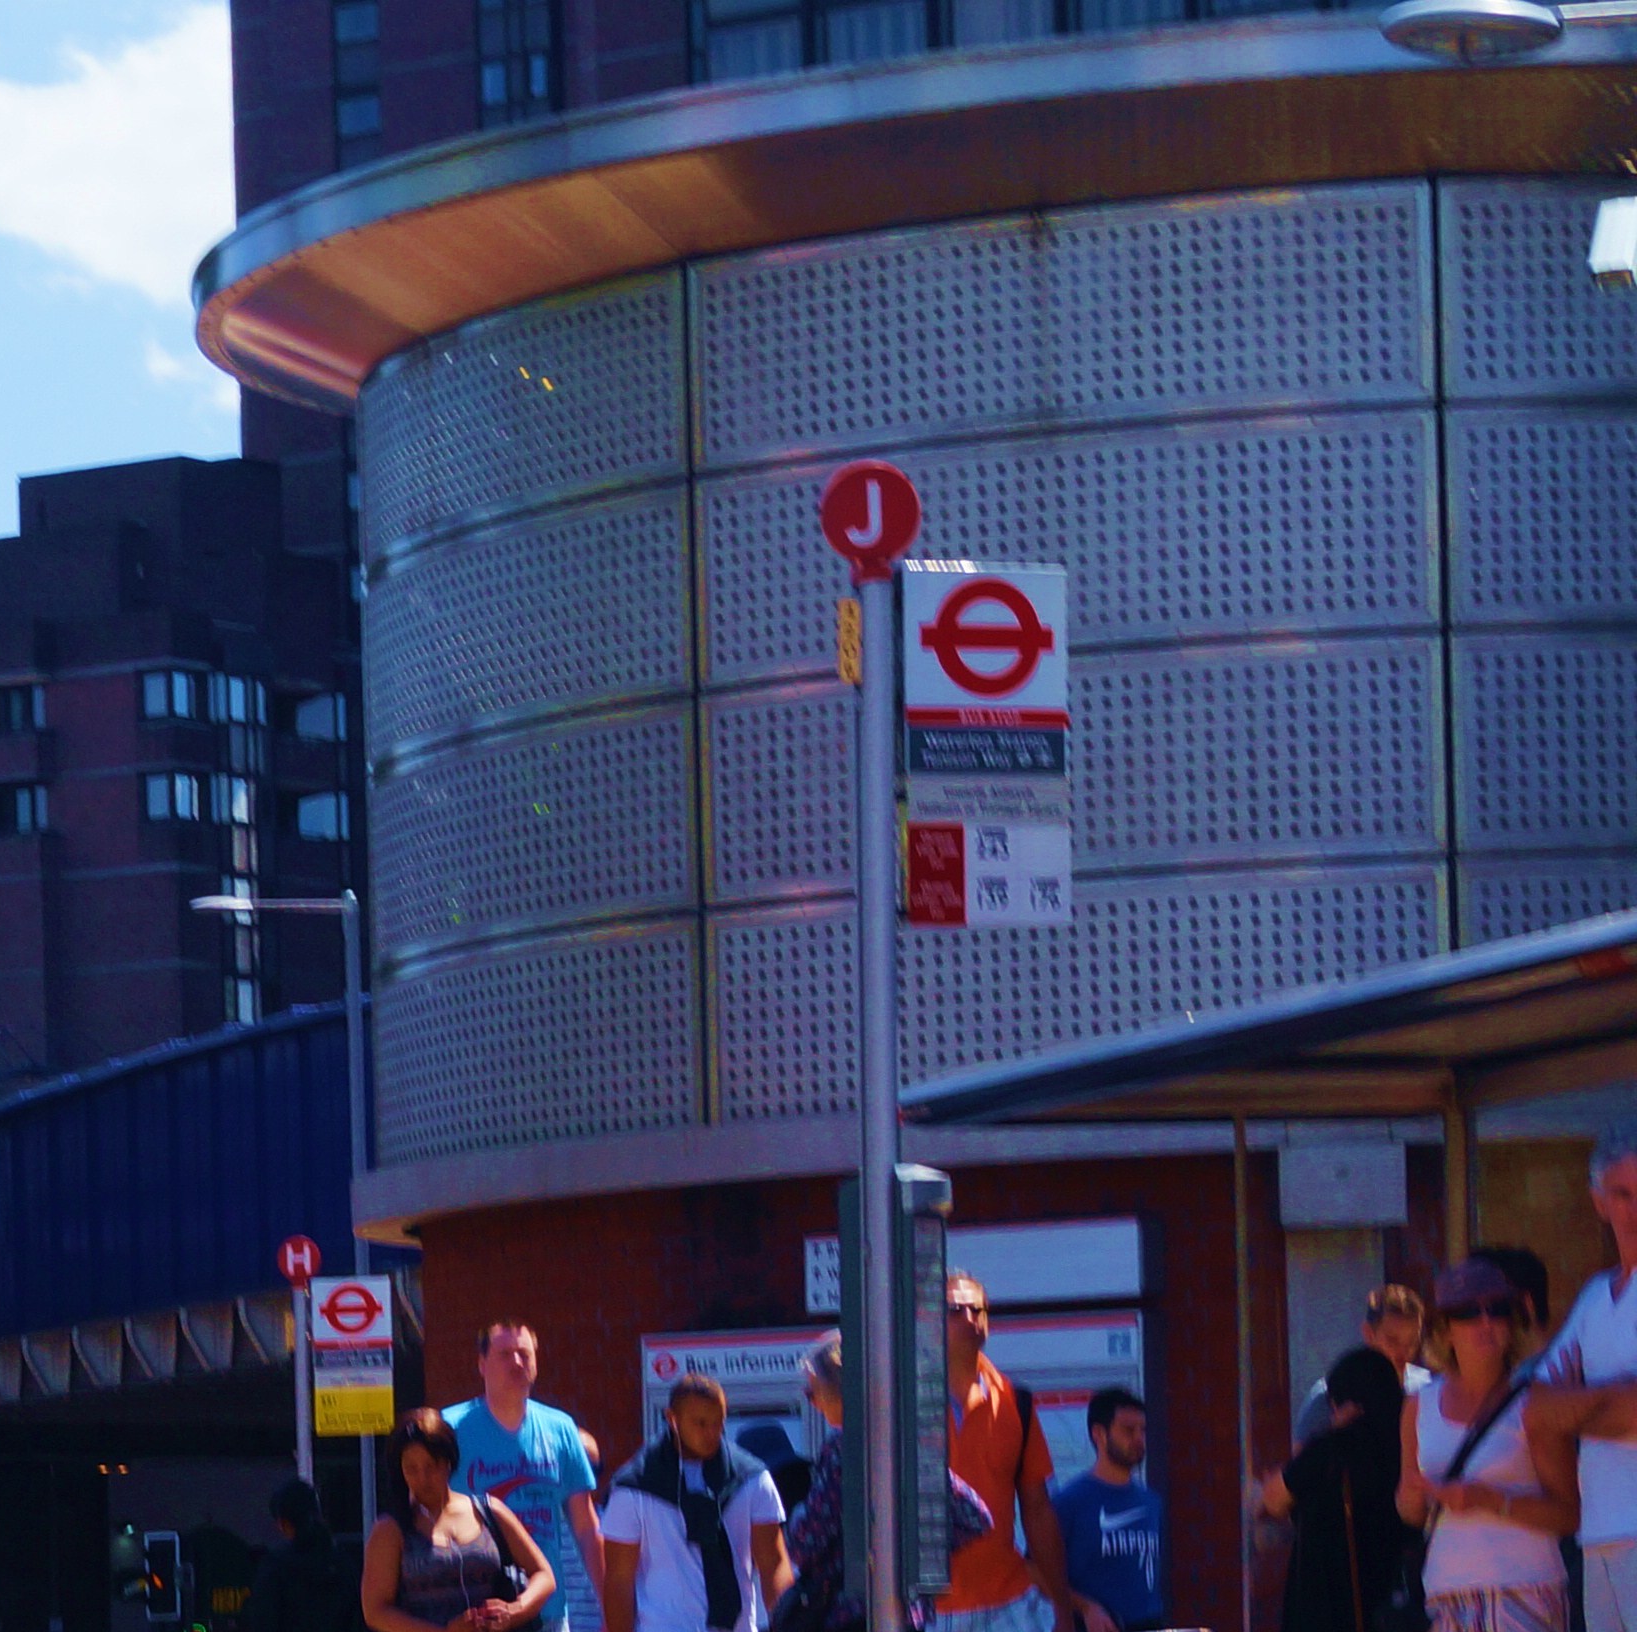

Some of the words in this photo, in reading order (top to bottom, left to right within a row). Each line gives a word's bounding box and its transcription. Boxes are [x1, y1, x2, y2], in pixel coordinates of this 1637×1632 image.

[844, 478, 883, 550] J
[287, 1243, 311, 1276] H
[685, 1353, 718, 1375] Bus
